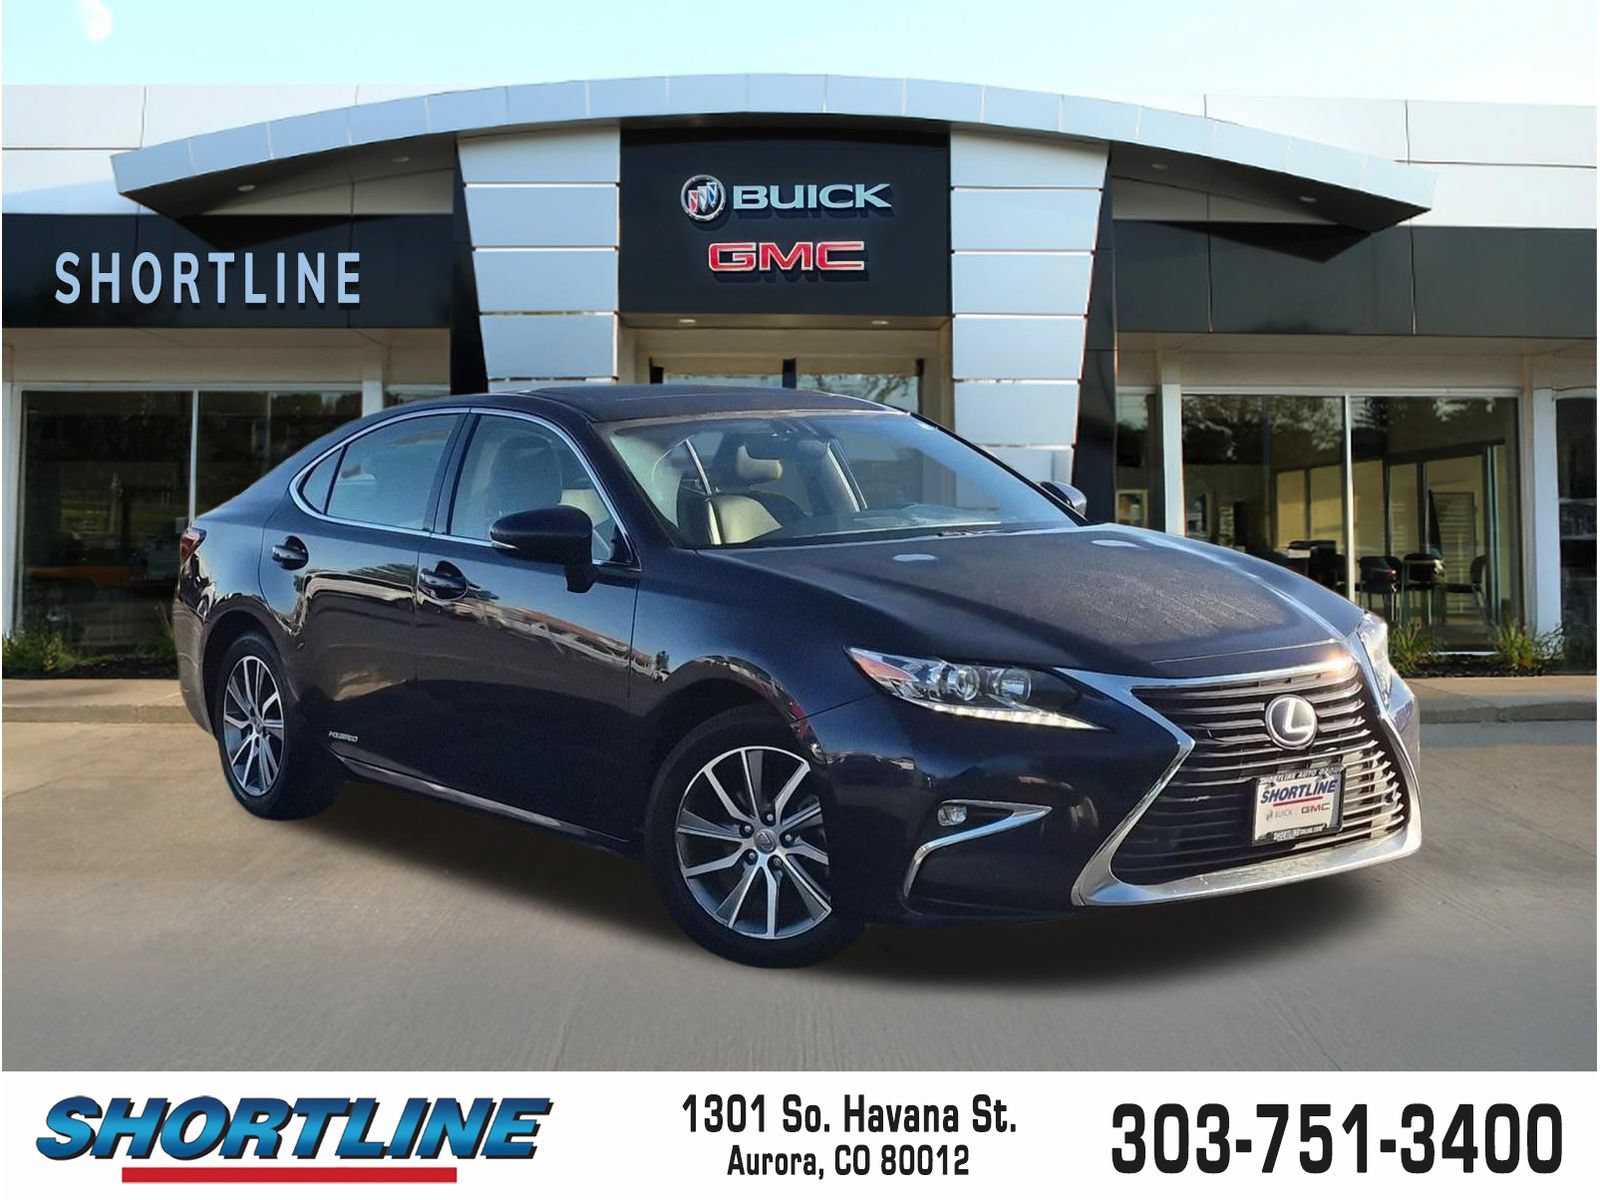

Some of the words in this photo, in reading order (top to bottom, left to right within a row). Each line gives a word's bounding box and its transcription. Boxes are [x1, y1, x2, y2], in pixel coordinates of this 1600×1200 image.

[732, 183, 893, 210] BUICK
[707, 240, 865, 272] GMC
[54, 251, 361, 305] SHORTLINE
[1261, 780, 1338, 804] SHORTLINE
[1301, 803, 1330, 814] GMC
